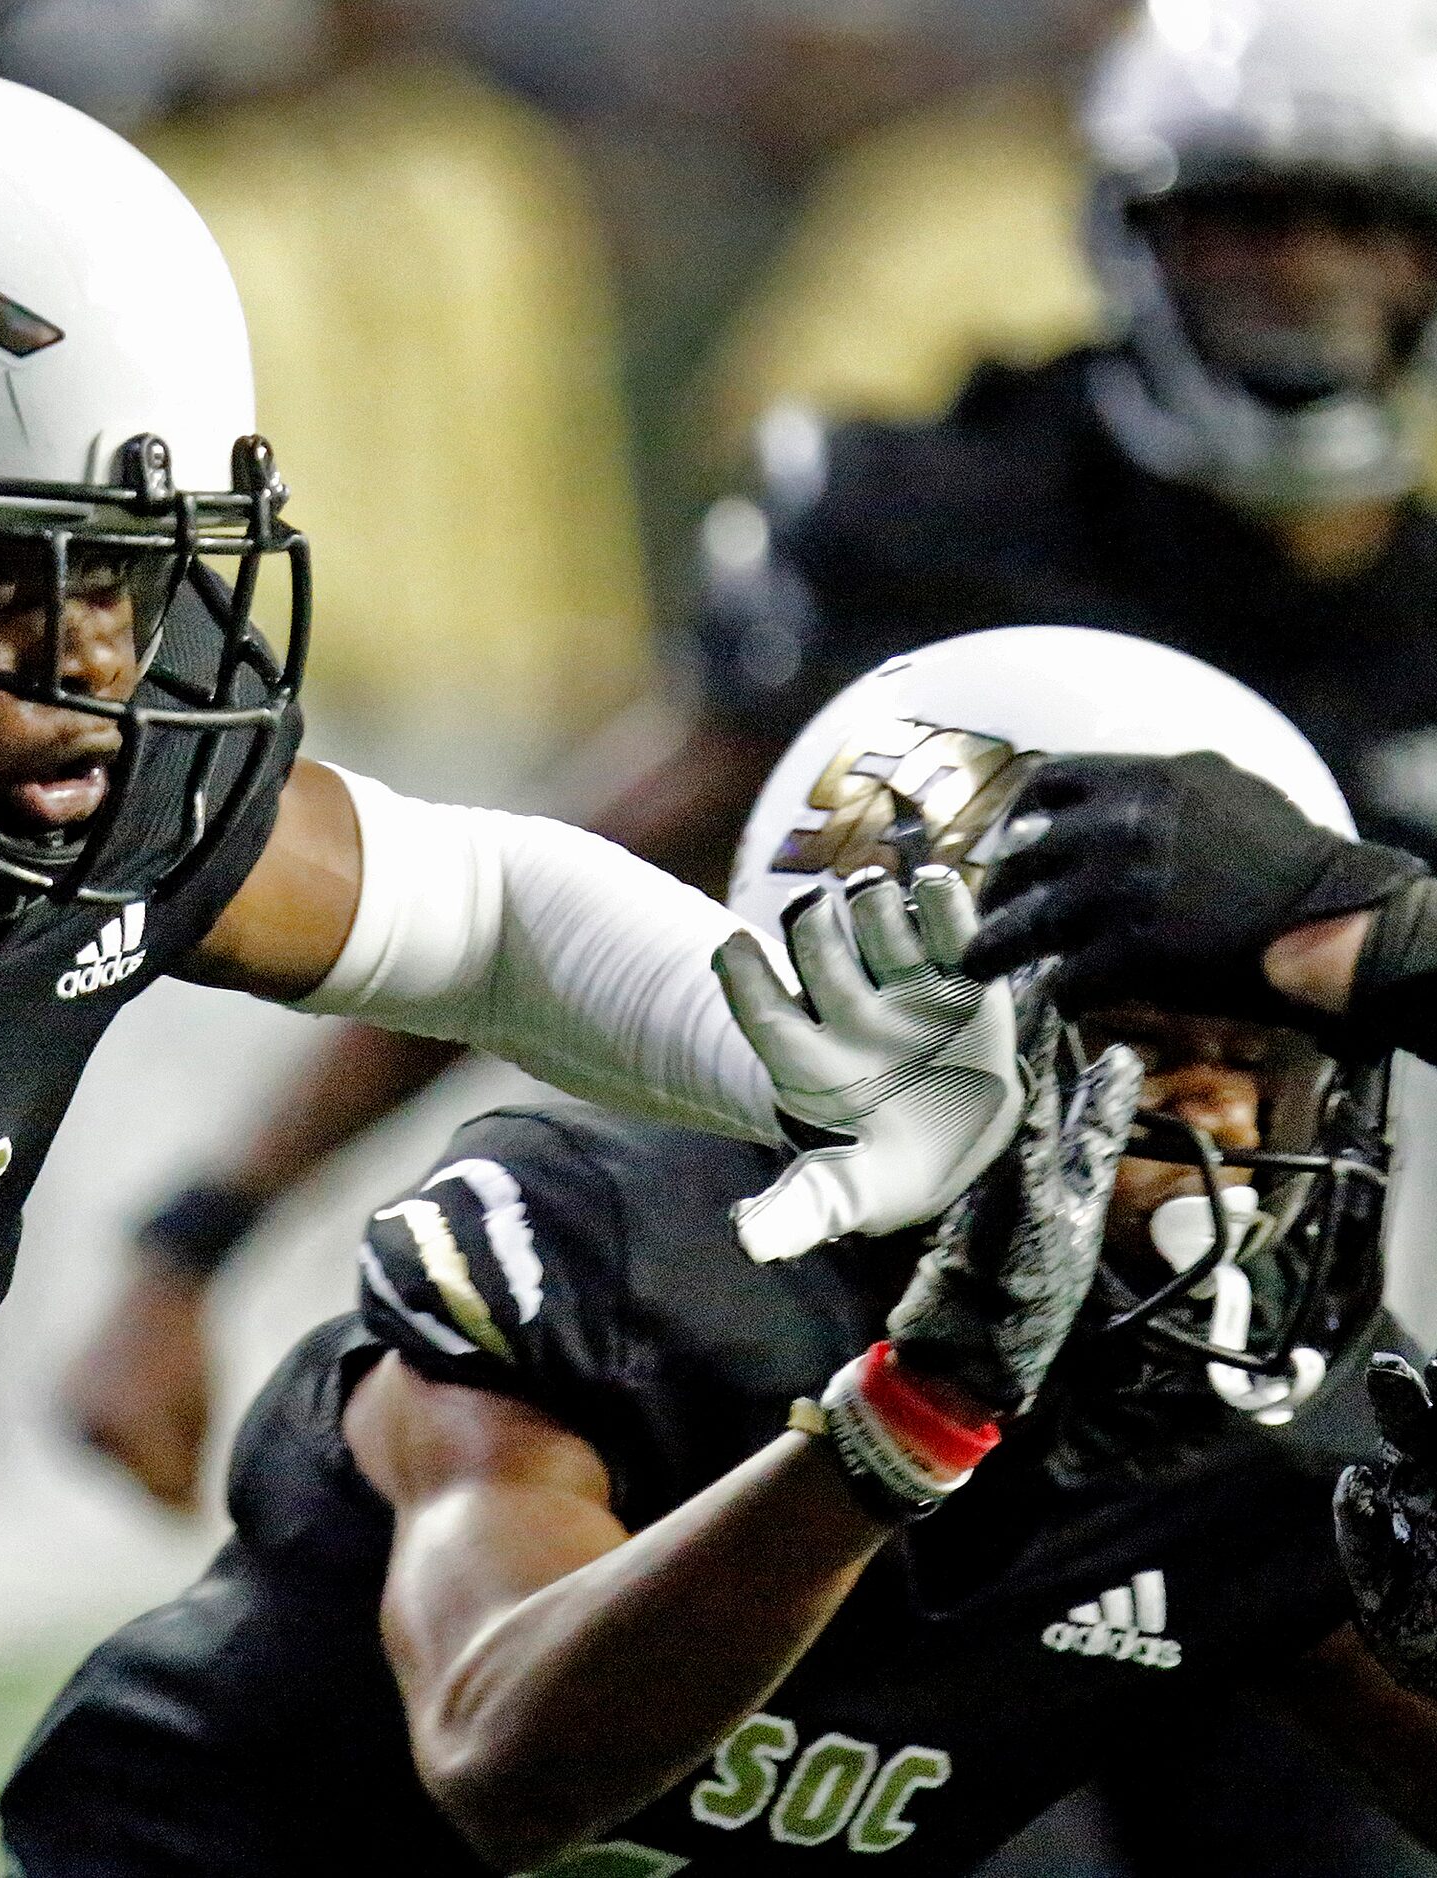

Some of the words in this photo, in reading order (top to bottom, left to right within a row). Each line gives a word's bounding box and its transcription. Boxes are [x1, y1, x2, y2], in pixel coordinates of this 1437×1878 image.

[55, 949, 147, 999] adidas
[1041, 1619, 1182, 1669] adidas
[689, 1712, 952, 1854] SOC
